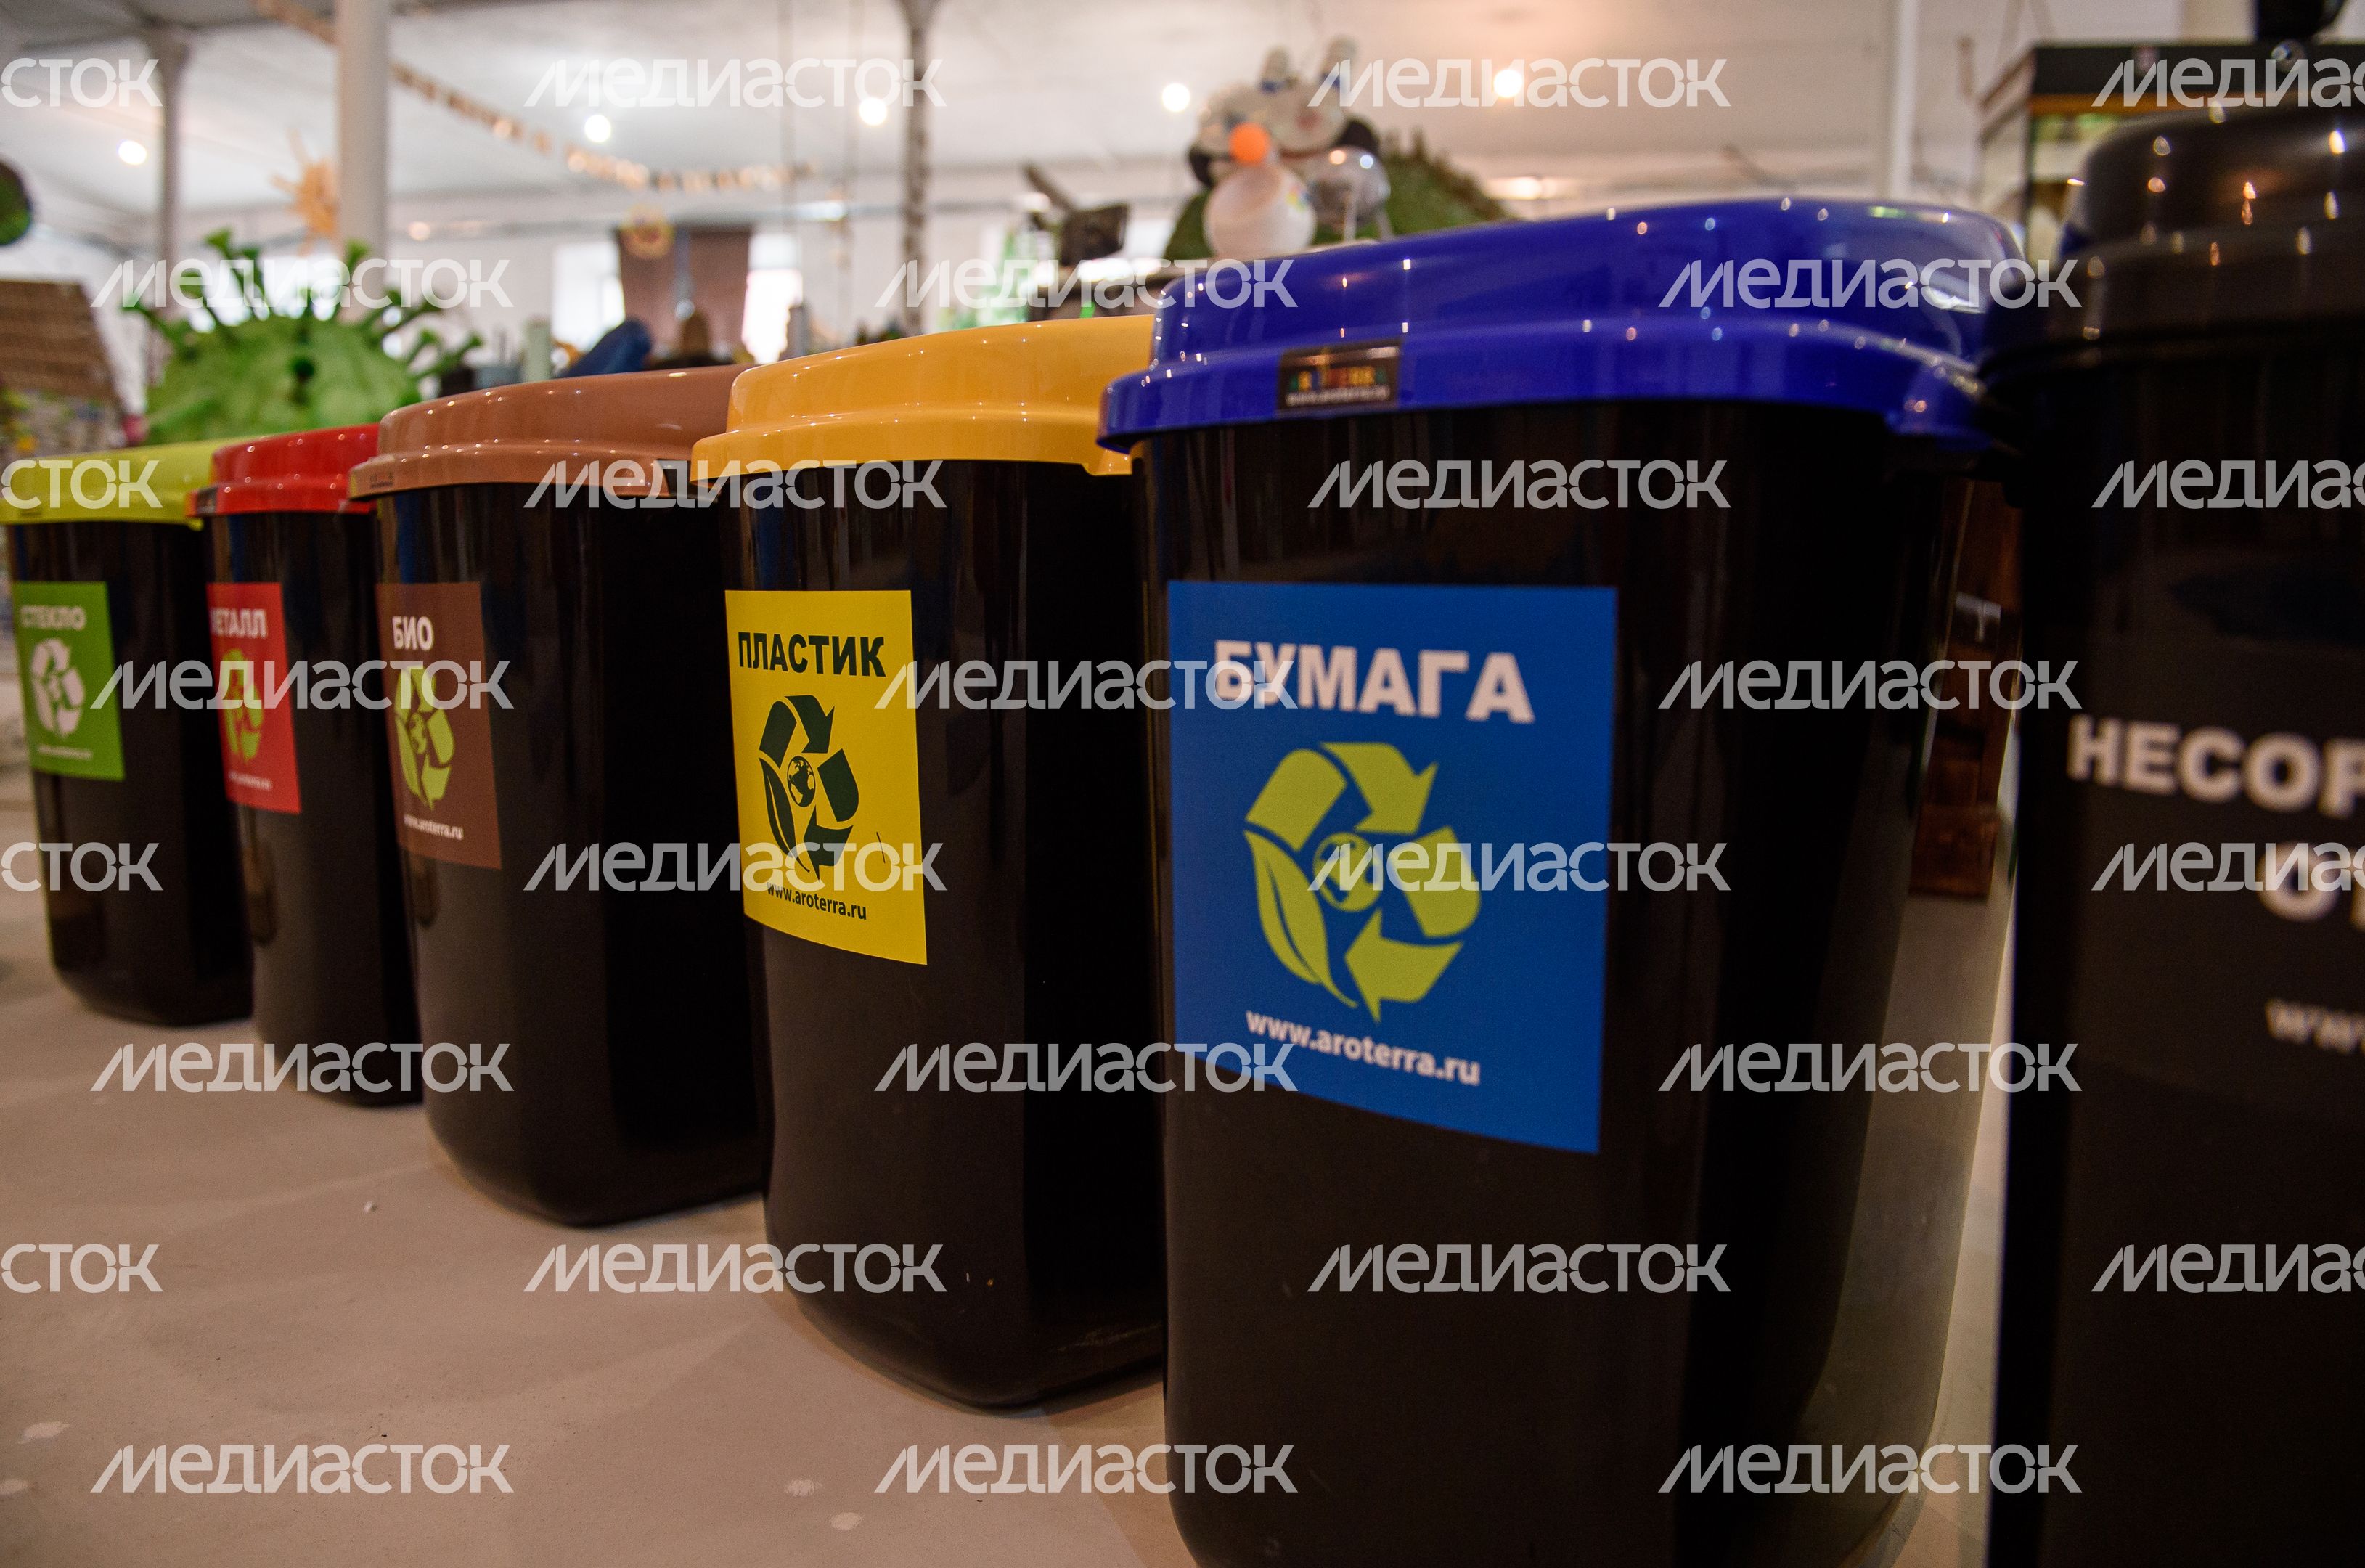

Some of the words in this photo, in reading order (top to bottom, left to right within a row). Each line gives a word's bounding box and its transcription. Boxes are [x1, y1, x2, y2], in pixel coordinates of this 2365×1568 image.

[392, 616, 435, 650] БИО
[738, 632, 886, 678] ПЛАСТИК
[1214, 640, 1536, 724] БУМАГА
[767, 882, 867, 920] www.aroterra.ru
[1246, 1010, 1481, 1087] www.aroterra.ru
